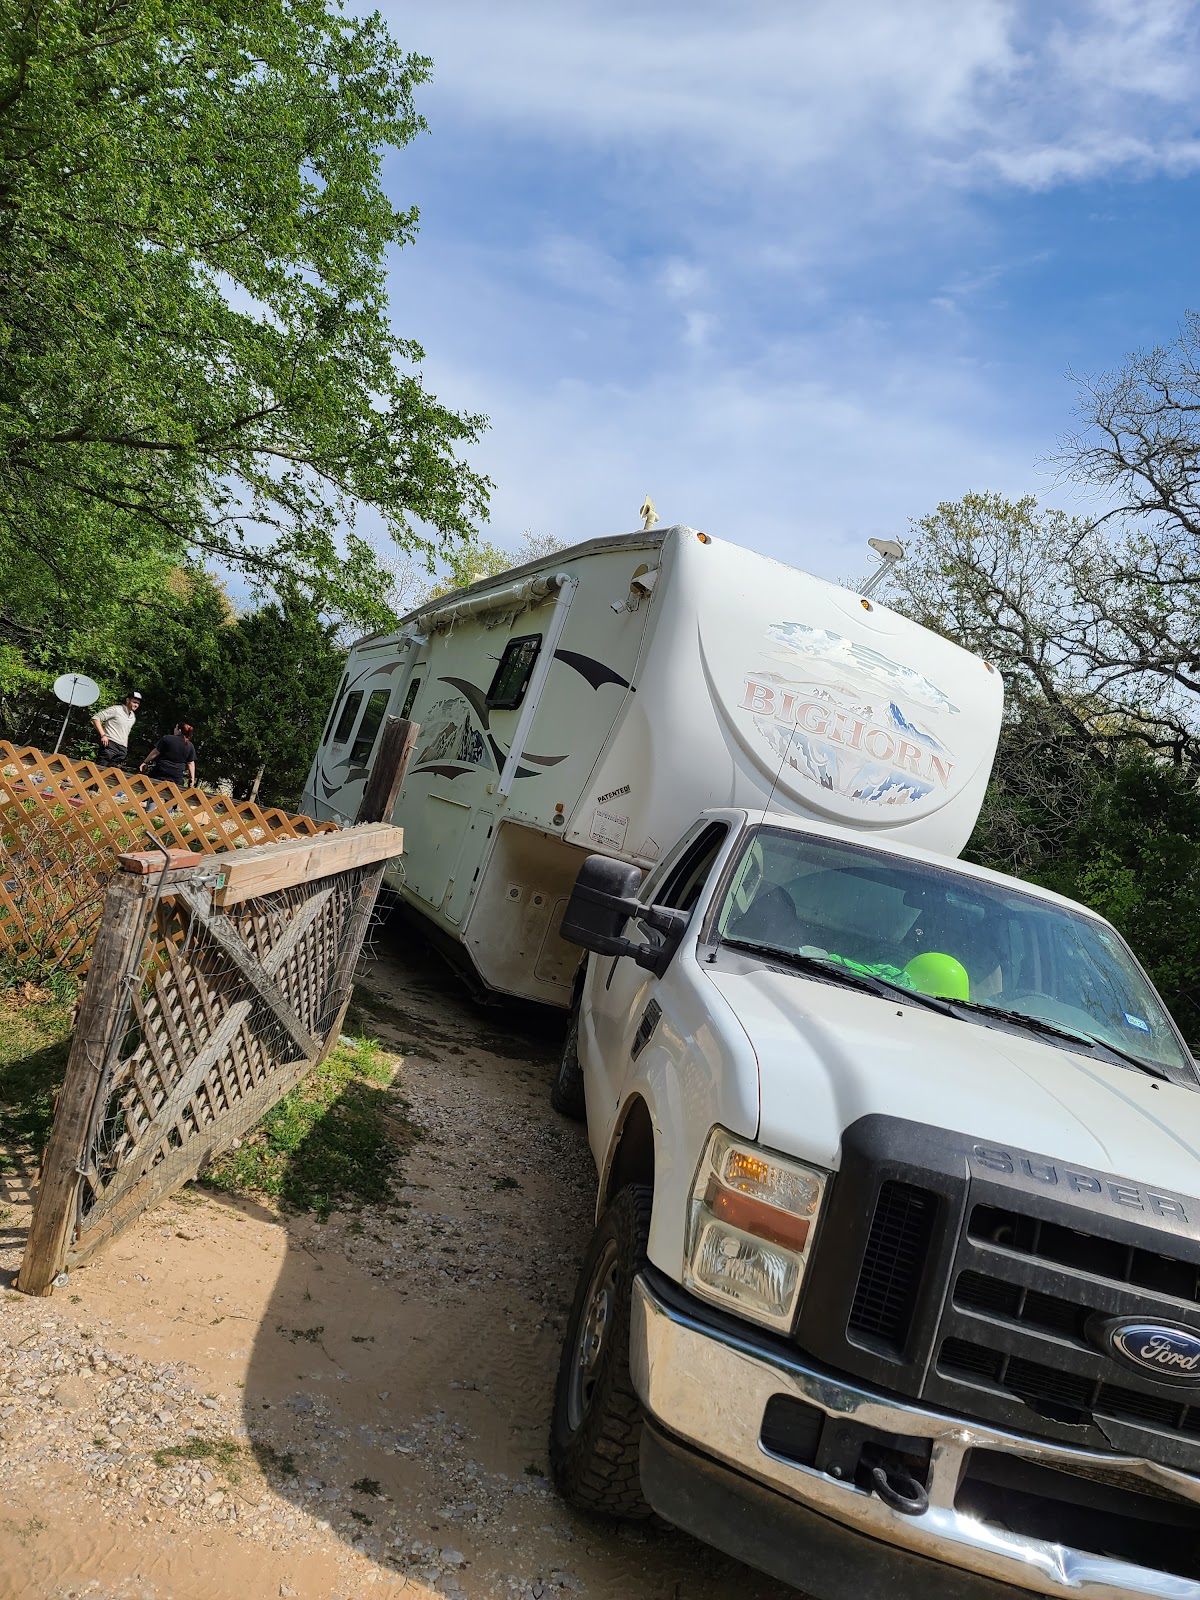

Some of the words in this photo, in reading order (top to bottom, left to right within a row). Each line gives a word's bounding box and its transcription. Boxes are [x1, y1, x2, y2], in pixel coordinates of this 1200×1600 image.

[737, 679, 955, 789] BIGHORN
[597, 784, 631, 803] PATENTED!
[974, 1144, 1189, 1224] SUPER
[1140, 1335, 1200, 1370] Ford
